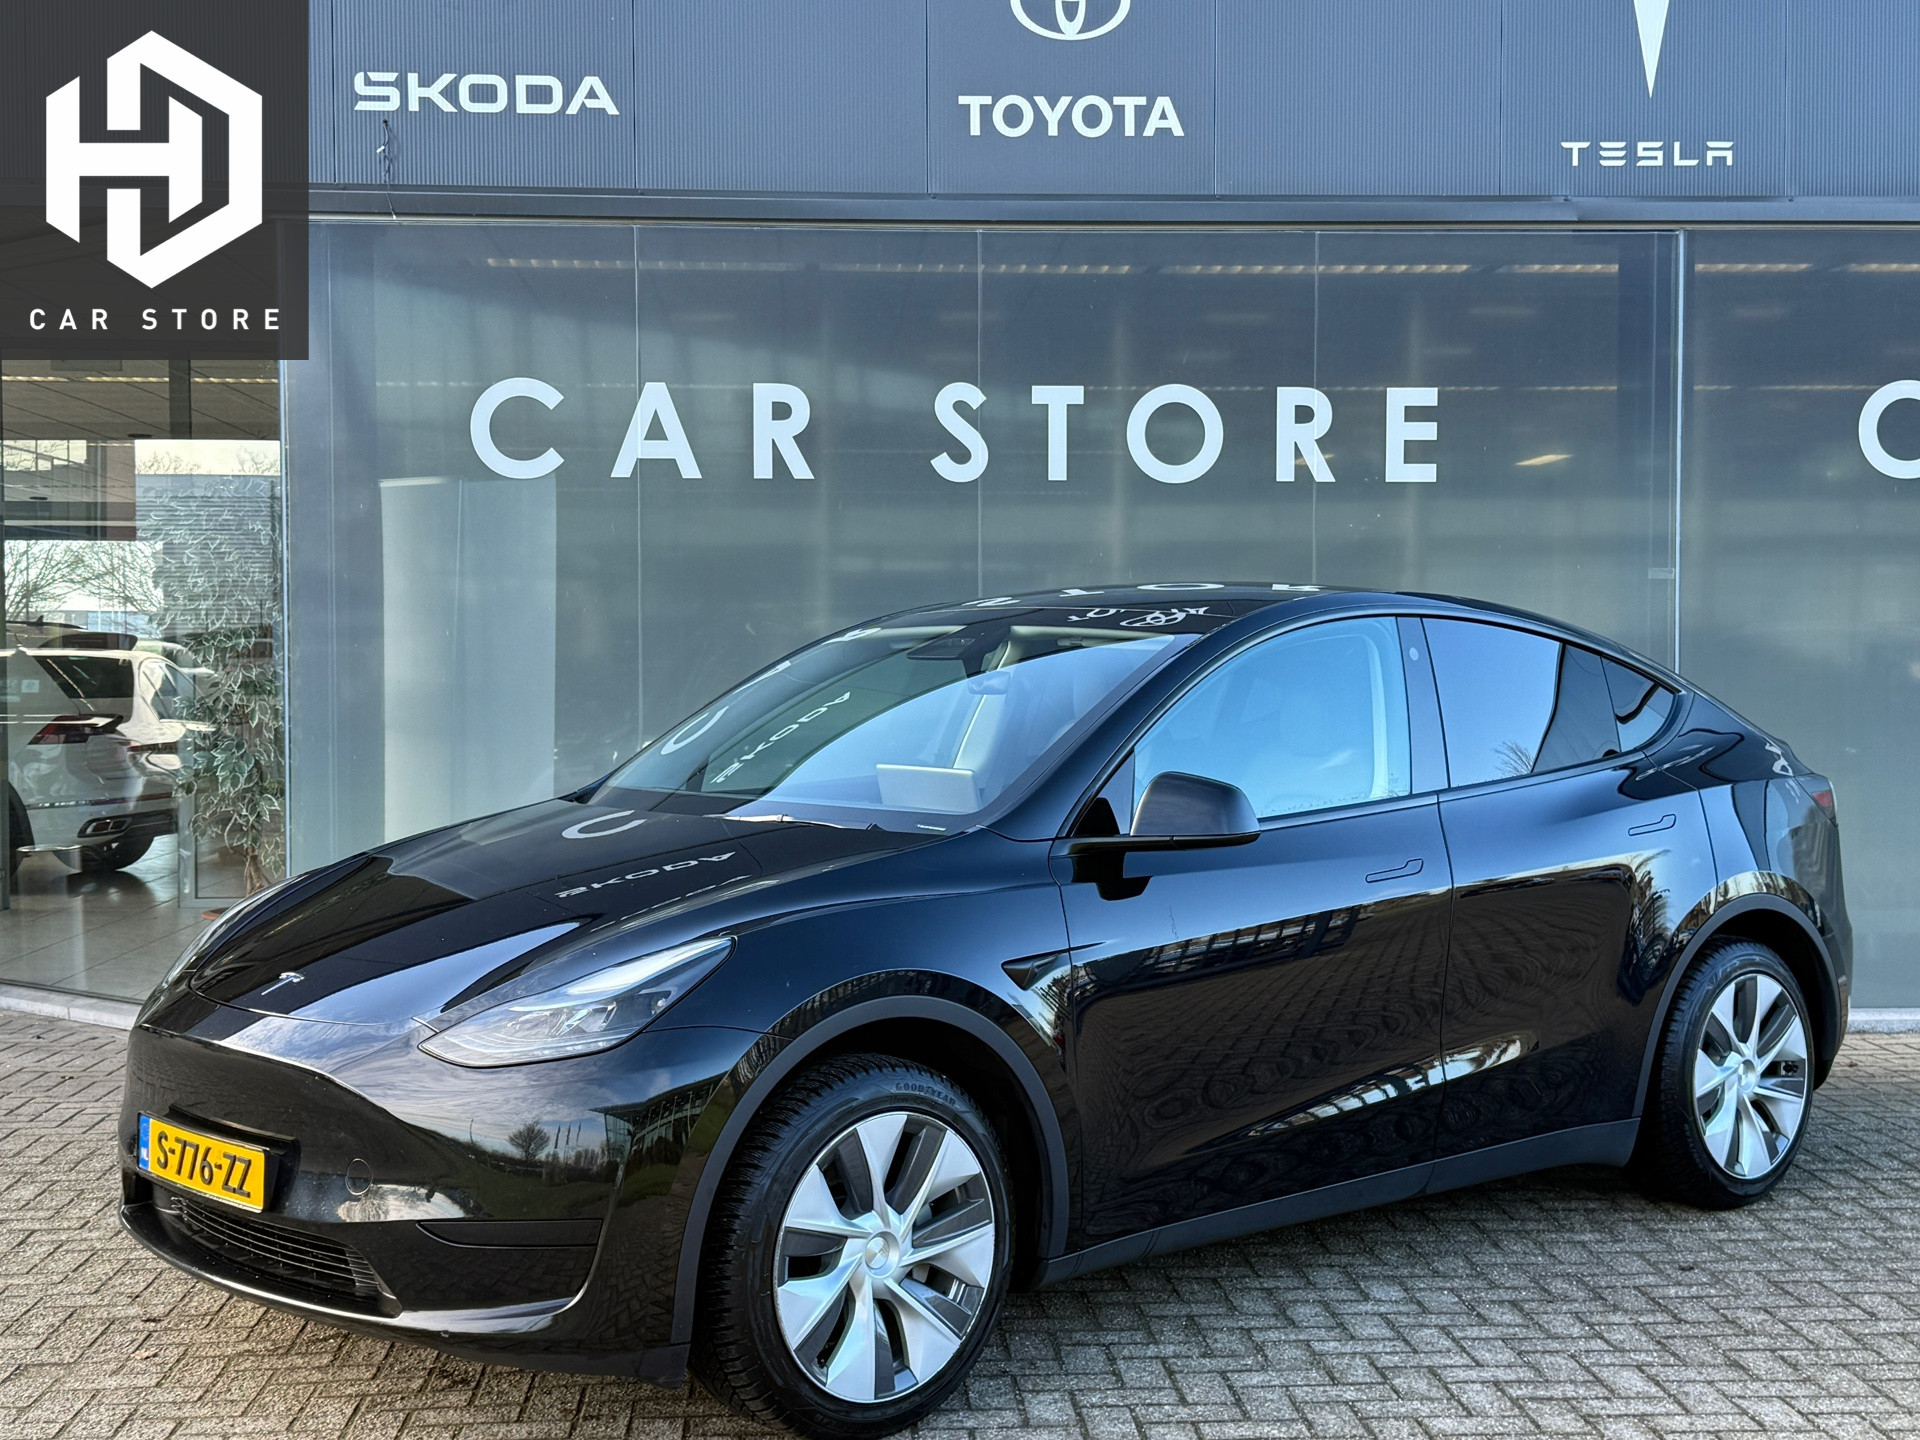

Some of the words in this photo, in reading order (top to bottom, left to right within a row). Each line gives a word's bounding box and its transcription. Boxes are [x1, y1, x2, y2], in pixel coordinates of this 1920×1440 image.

[353, 71, 620, 116] SKODA
[958, 95, 1185, 138] TOYOTA
[1561, 141, 1735, 167] TESLA
[470, 377, 815, 480] CAR
[930, 382, 1439, 484] STORE
[1858, 379, 1920, 479] C
[157, 1130, 252, 1198] S-776-ZZ
